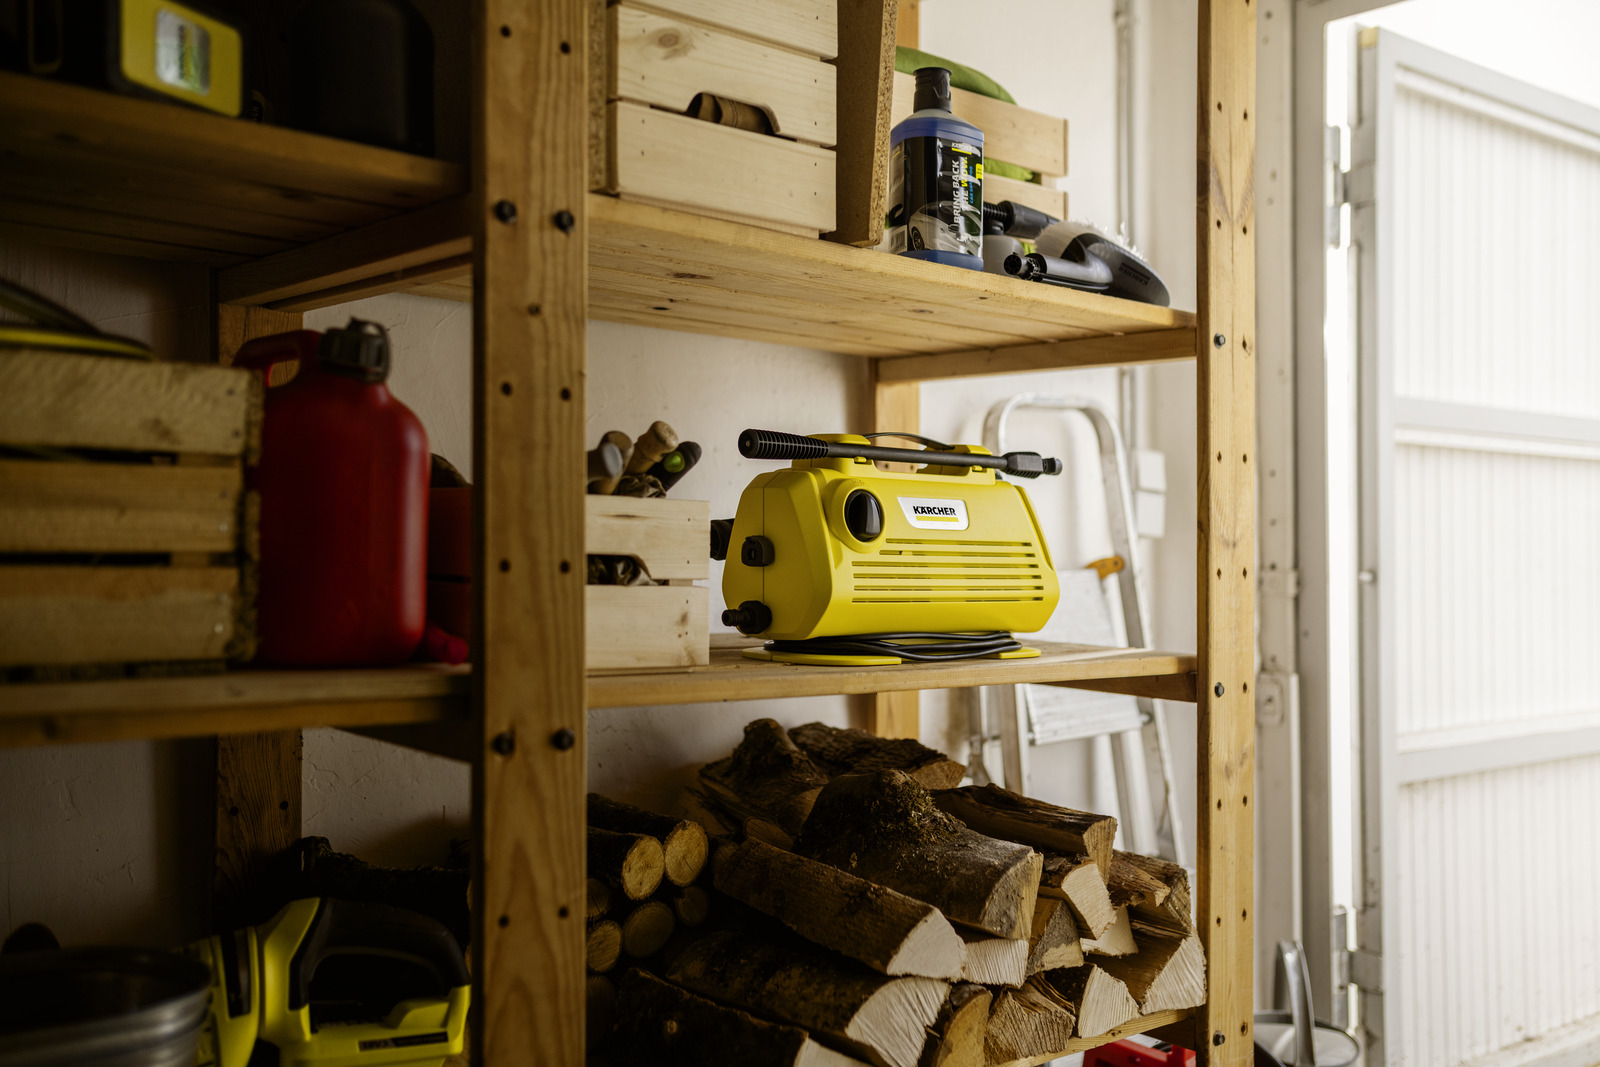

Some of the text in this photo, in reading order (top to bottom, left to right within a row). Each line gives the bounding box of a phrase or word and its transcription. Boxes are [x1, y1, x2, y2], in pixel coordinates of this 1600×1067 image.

[952, 159, 961, 224] BRING BACK
[912, 505, 957, 516] KÄRCHER
